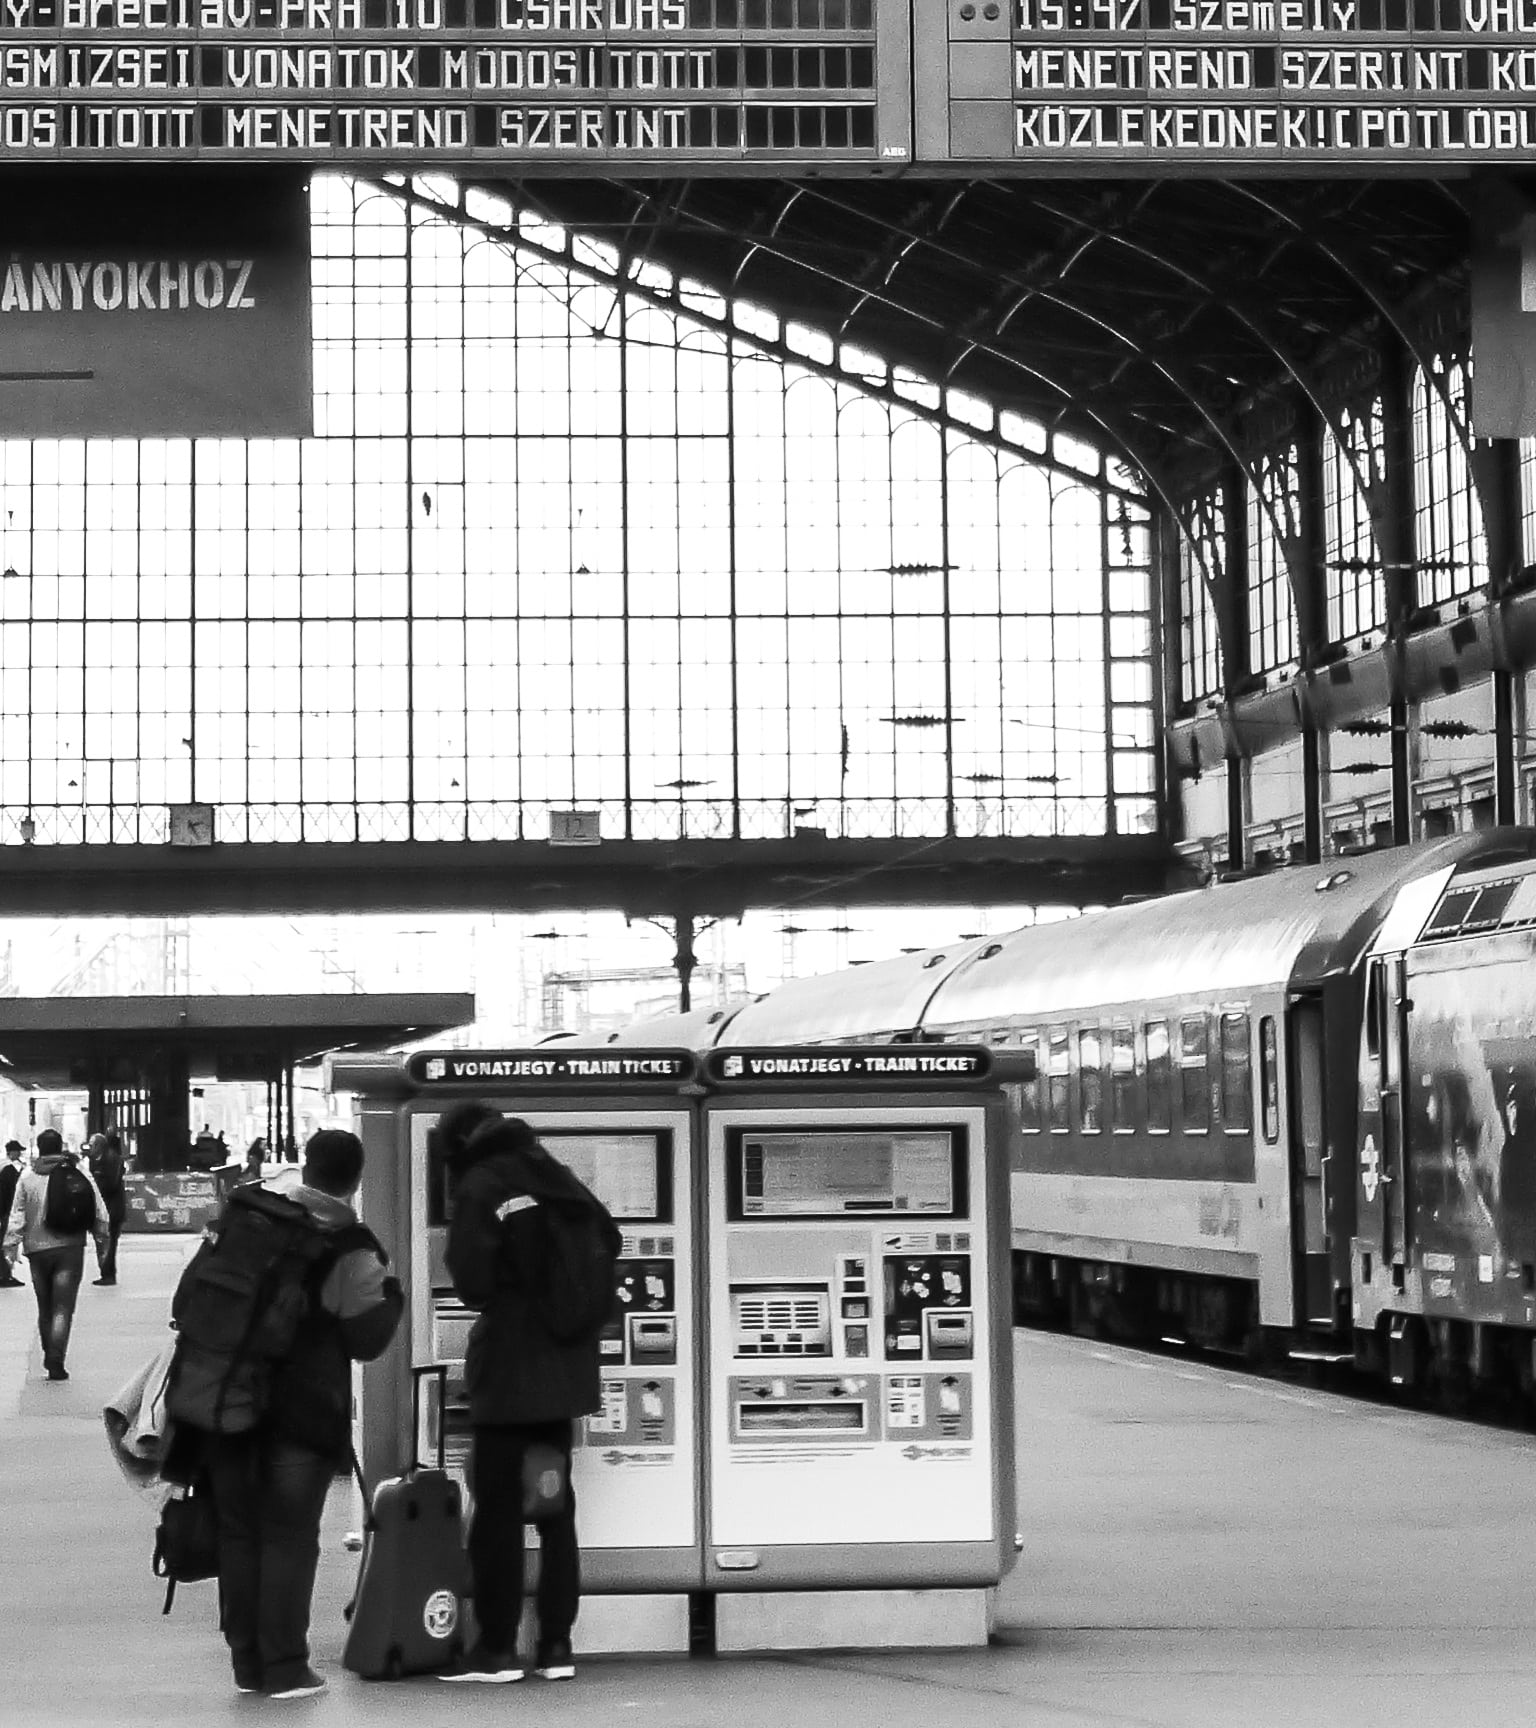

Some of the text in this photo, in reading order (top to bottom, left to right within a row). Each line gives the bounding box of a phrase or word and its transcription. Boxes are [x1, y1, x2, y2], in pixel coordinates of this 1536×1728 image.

[227, 48, 415, 87] VONATOK
[1013, 50, 1251, 89] MENETREND
[1280, 51, 1463, 89] SZERINT
[227, 107, 470, 146] MENETREND
[500, 108, 688, 146] SZERINT
[882, 147, 907, 157] AEG
[453, 1062, 556, 1077] VONATJEGY
[567, 1060, 621, 1075] TRAIN
[750, 1058, 851, 1073] VONATJEGY
[864, 1057, 917, 1072] TRAIN
